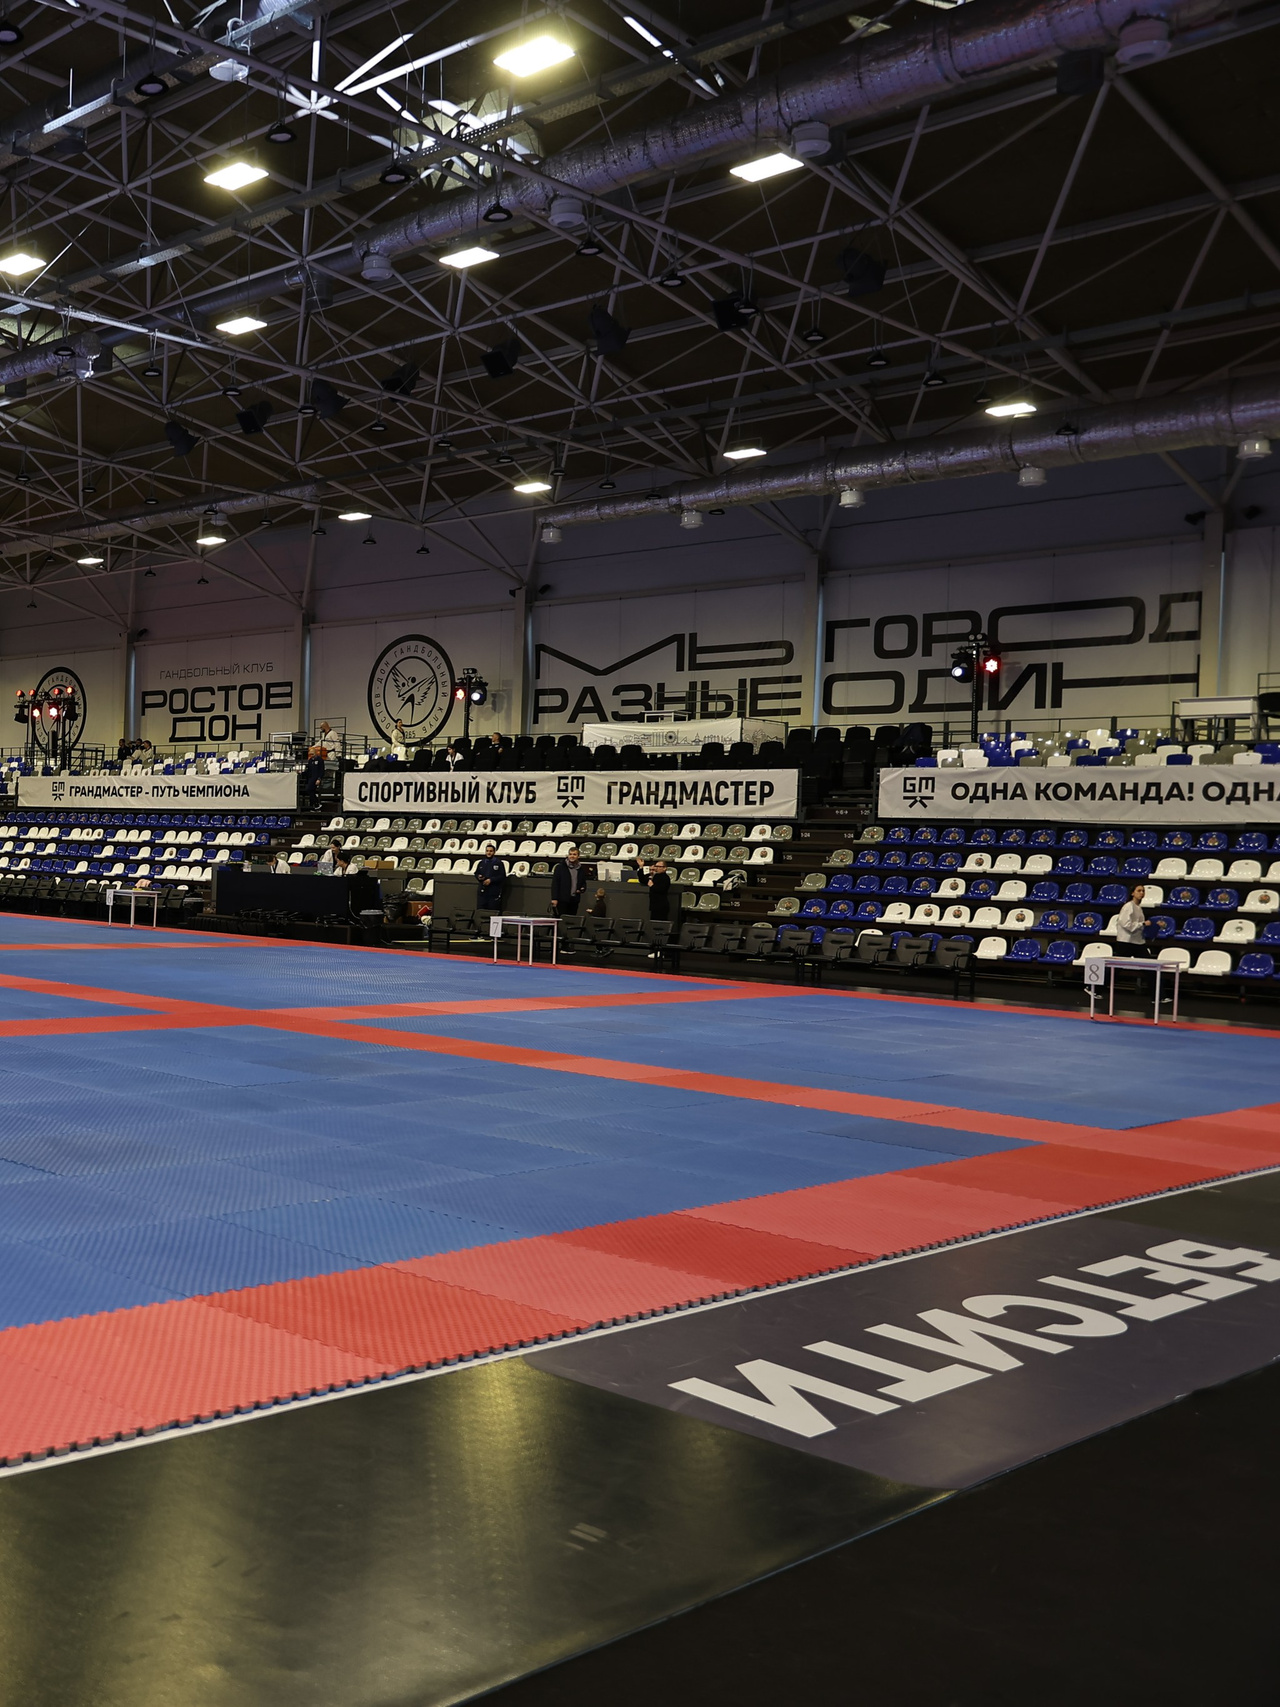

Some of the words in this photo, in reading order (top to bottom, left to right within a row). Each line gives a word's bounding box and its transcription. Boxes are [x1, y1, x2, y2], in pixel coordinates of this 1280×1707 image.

[824, 591, 1203, 663] ГОРОД
[160, 663, 240, 680] ГАНДБОЛЬНЫЙ
[243, 662, 274, 674] КЛУБ
[823, 653, 1201, 715] ОДИН
[141, 681, 293, 716] РОСТОВ
[394, 644, 449, 698] ГАНДБОЛЬНЫЙ
[422, 706, 444, 734] КЛУБ
[532, 675, 803, 724] РАЗНЫЕ
[169, 713, 262, 743] ДОН
[70, 785, 143, 799] ГРАНДМАСТЕР
[152, 786, 179, 798] ПУТЬ
[182, 785, 250, 798] ЧЕМПИОНА
[358, 776, 481, 804] СПОРТИВНЫЙ
[486, 780, 537, 804] КЛУБ
[557, 776, 584, 793] GM
[607, 780, 774, 809] ГРАНДМАСТЕР
[903, 777, 935, 794] GM
[951, 782, 1027, 804] ОДНА
[1035, 782, 1194, 805] КОМАНДА!
[1202, 782, 1280, 805] ОДН
[493, 922, 499, 935] 7
[1089, 964, 1099, 982] 8
[667, 1239, 1280, 1438] БЕТСИТИ
